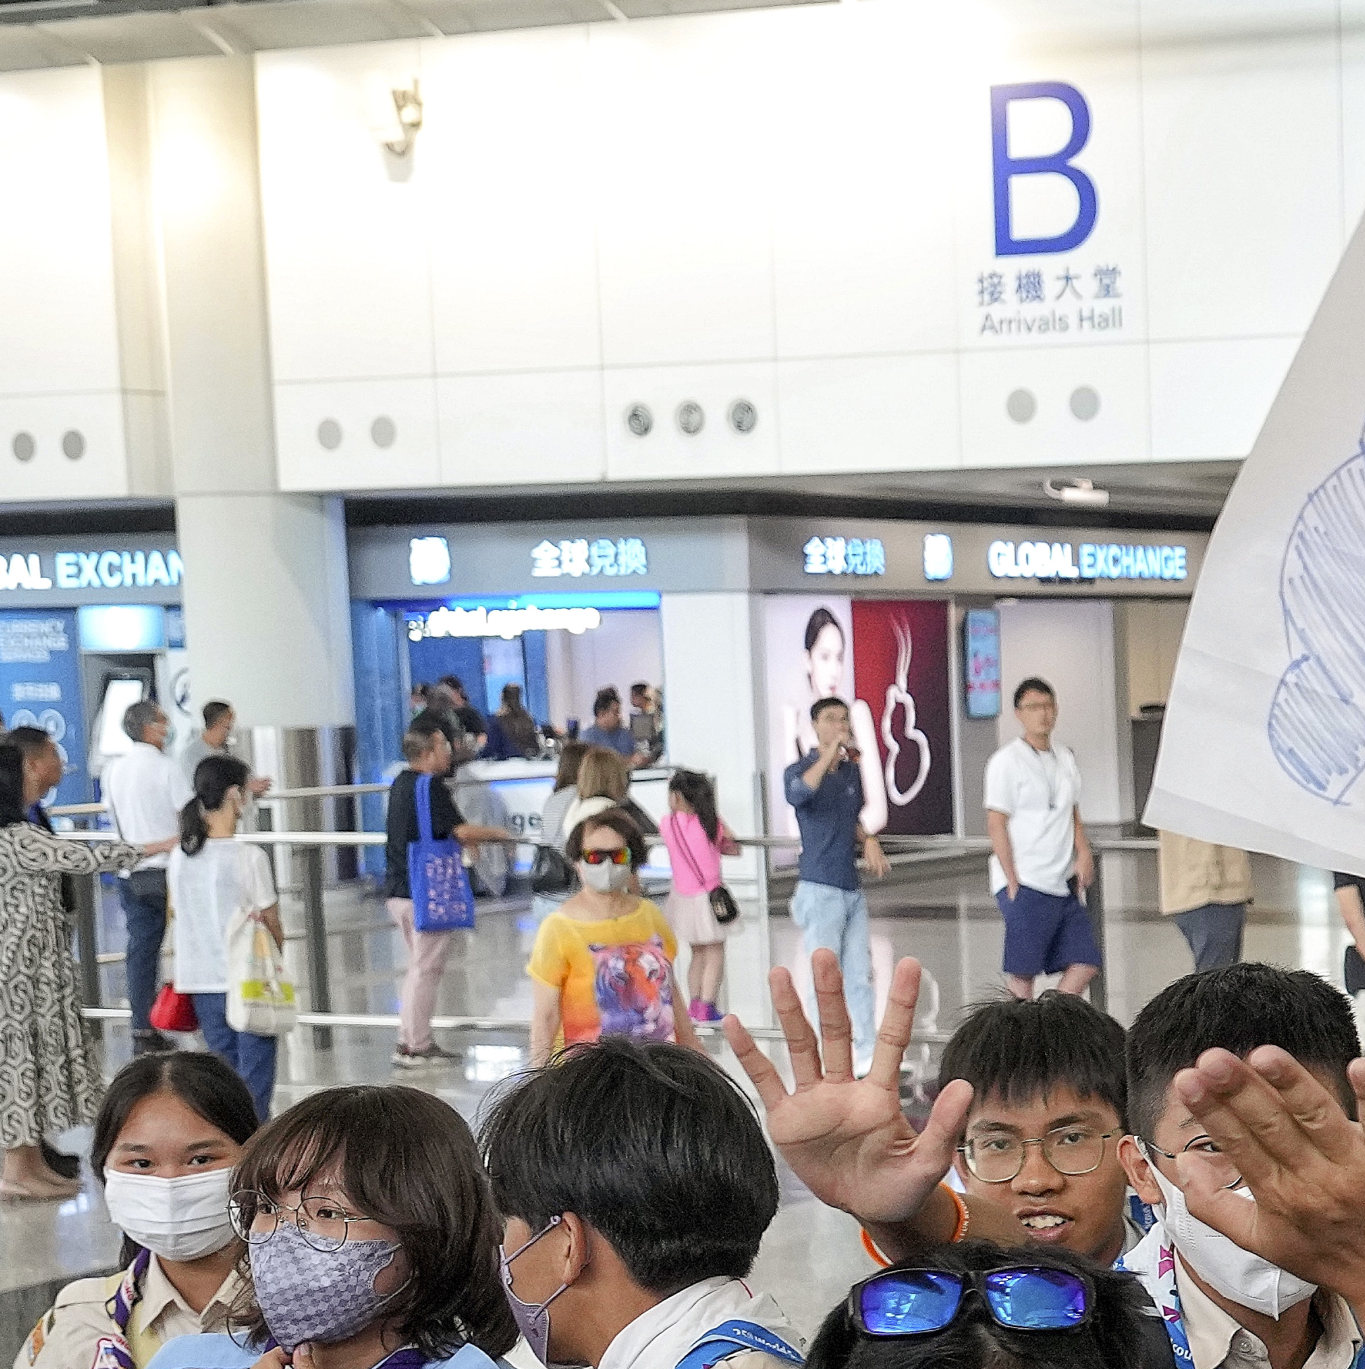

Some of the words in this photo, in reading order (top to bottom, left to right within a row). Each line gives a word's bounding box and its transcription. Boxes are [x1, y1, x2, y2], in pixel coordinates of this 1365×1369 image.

[991, 82, 1096, 257] B
[980, 310, 1070, 336] Arrivals
[1078, 305, 1124, 330] Hall
[987, 540, 1079, 578] GLOBAL
[1079, 543, 1188, 579] EXCHANGE
